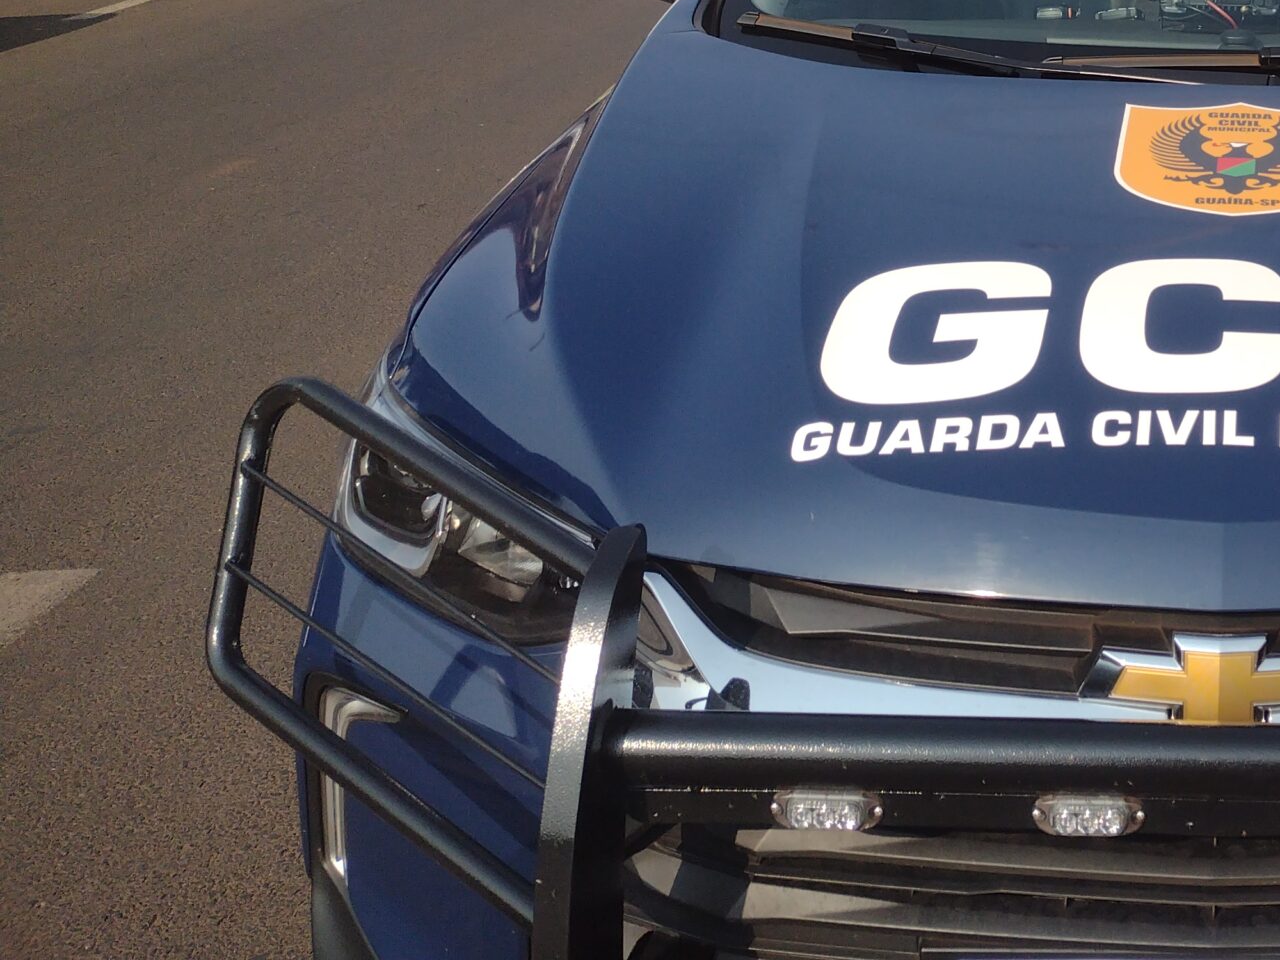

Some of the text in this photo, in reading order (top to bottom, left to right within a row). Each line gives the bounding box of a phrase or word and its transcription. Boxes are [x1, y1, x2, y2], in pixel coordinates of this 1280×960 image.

[1207, 111, 1273, 120] GUARDA
[1218, 119, 1261, 127] CIVIL
[790, 412, 1065, 463] GUARDA
[1091, 410, 1255, 448] CIVIL
